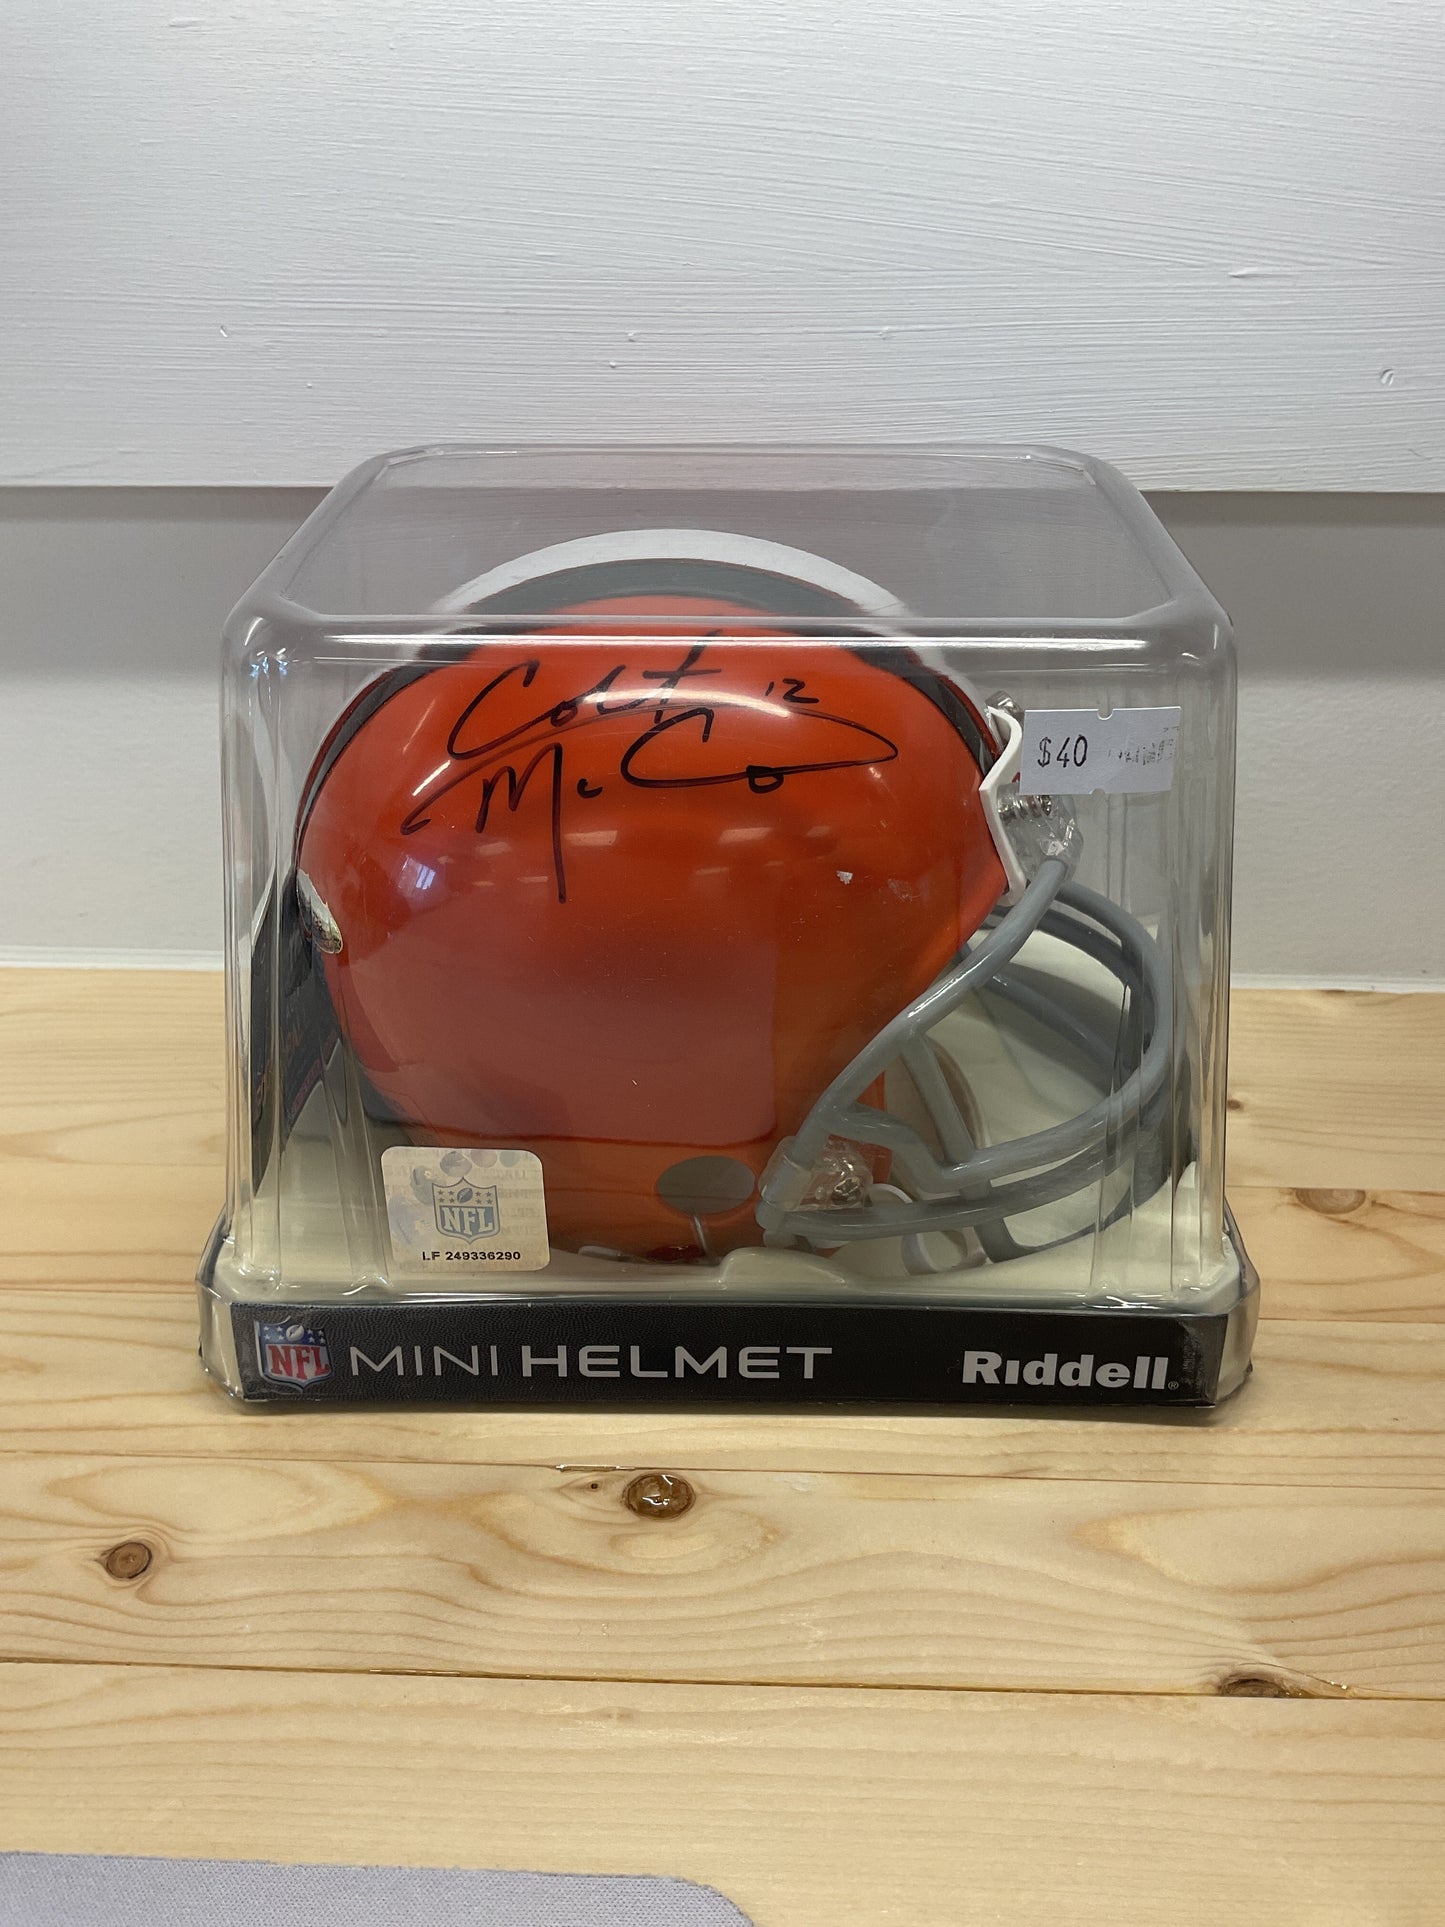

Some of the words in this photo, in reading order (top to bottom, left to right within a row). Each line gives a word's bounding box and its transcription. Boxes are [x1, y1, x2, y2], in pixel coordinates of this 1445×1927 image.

[766, 678, 819, 704] 12
[1037, 734, 1088, 768] $40
[442, 1207, 494, 1236] NFL
[422, 1252, 440, 1261] LF
[446, 1252, 521, 1261] 249336290
[268, 1344, 331, 1381] NFL
[350, 1345, 499, 1377] MINI
[522, 1345, 833, 1380] HELMET
